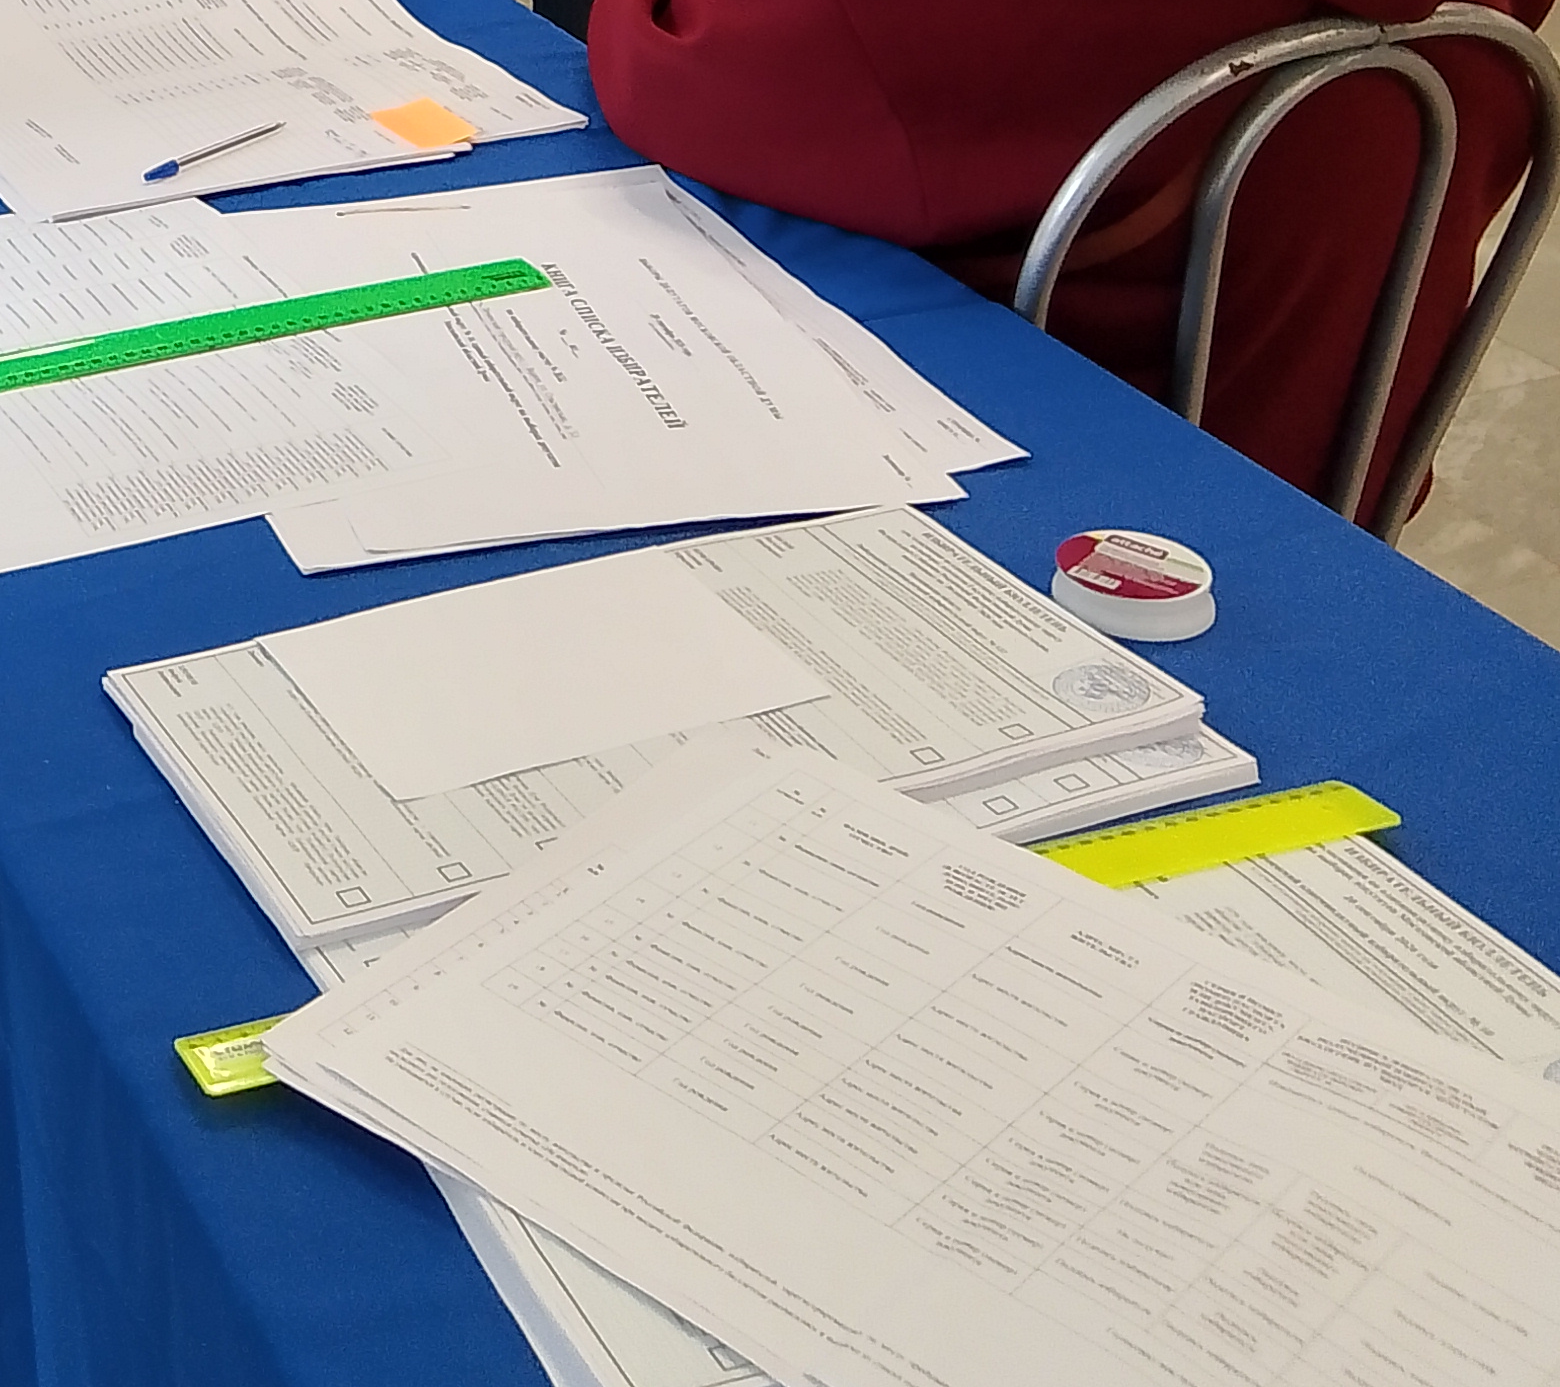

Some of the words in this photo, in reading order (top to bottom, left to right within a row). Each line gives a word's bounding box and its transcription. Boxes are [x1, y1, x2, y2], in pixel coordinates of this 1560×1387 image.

[541, 262, 578, 298] КНИГА
[570, 298, 616, 345] СПИСКА
[606, 344, 689, 430] ИЗБИРАТЕЛЕЙ
